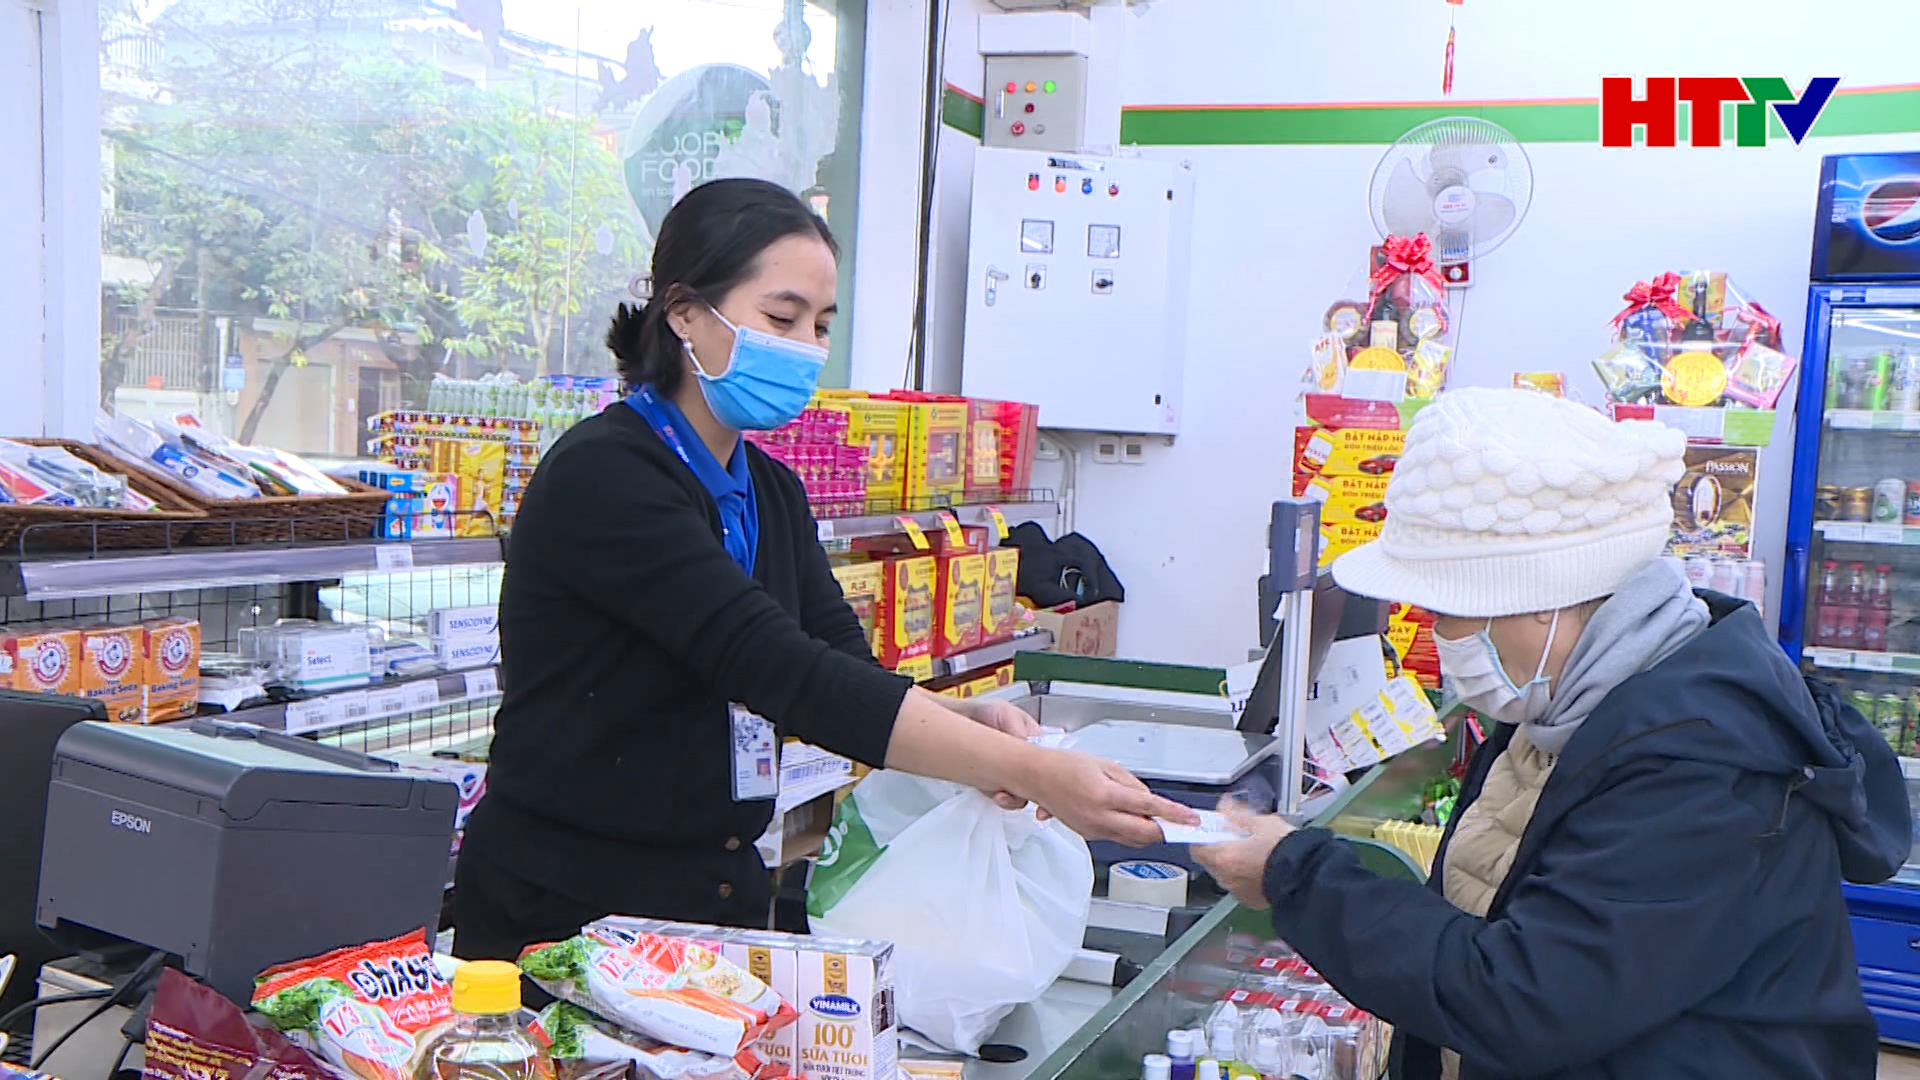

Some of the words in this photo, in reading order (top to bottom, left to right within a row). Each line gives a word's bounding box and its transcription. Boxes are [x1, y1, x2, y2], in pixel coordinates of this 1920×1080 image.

[449, 615, 495, 630] SENSODYNE
[451, 643, 494, 659] SENSODYNE
[112, 809, 151, 833] EPSON
[812, 998, 859, 1013] VINAMILK
